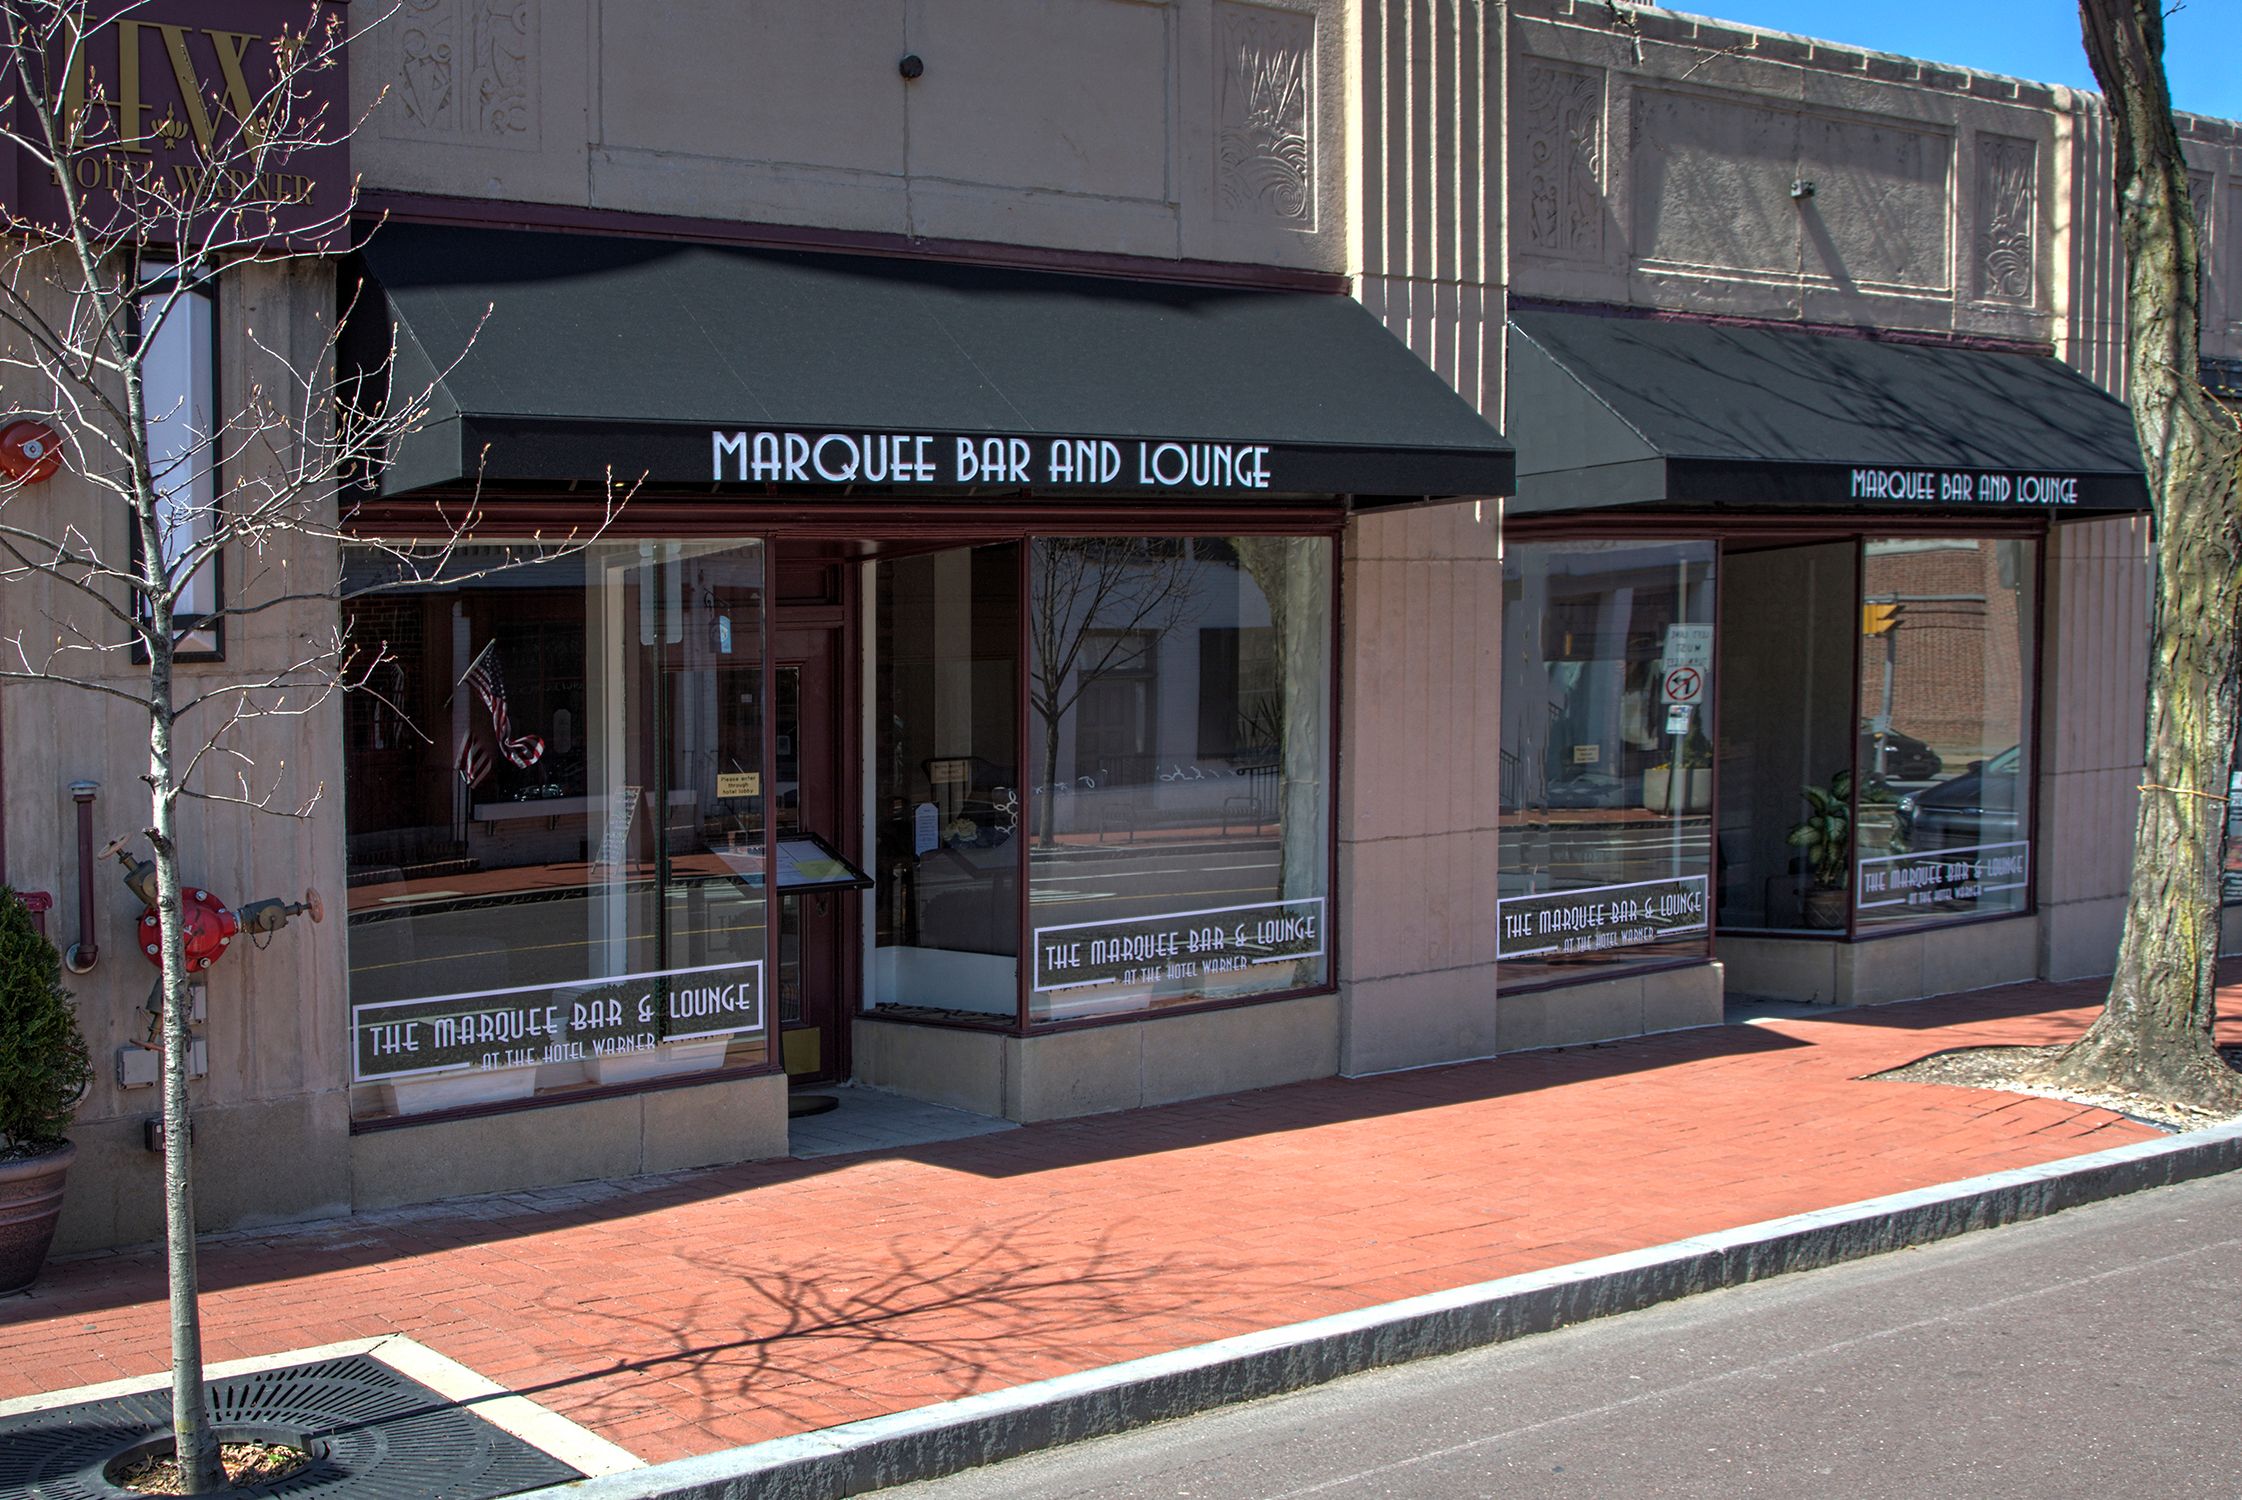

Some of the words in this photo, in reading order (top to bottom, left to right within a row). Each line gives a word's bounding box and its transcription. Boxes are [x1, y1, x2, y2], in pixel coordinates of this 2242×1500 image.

[172, 163, 315, 206] WARNER
[711, 430, 937, 483] MARQUEE
[956, 436, 1032, 484] BAR
[1048, 438, 1123, 485] AND
[1139, 441, 1272, 488] LOUNGE
[1850, 468, 1936, 500] MARQUEE
[1941, 472, 1974, 501] BAR
[1977, 474, 2011, 502] AND
[2015, 475, 2078, 504] LOUNGE
[1864, 872, 1886, 892] THE
[1890, 864, 1943, 889] MARQUEE
[1946, 861, 1969, 881] BAR
[1974, 860, 1982, 879] &
[1987, 855, 2023, 877] LOUNGE
[1505, 912, 1532, 938] THE
[1539, 903, 1605, 934] MARQUEE
[1609, 899, 1638, 924] BAR
[1644, 897, 1653, 919] &
[1660, 891, 1702, 917] LOUNGE
[1045, 943, 1081, 970] THE
[1091, 932, 1179, 965] MARQUEE
[1187, 926, 1225, 953] BAR
[1235, 923, 1247, 947] &
[1257, 916, 1316, 945] LOUNGE
[1562, 938, 1574, 953] AT
[1576, 935, 1591, 952] THE
[1595, 931, 1618, 950] HOTEL
[1620, 926, 1654, 944] WARNER
[1123, 970, 1138, 985] AT
[1140, 966, 1161, 983] THE
[1166, 961, 1198, 980] HOTEL
[1201, 956, 1248, 975] WARNER
[369, 1022, 419, 1056] THE
[434, 1005, 558, 1048] MARQUEE
[569, 998, 623, 1031] BAR
[637, 994, 655, 1023] &
[669, 983, 751, 1019] LOUNGE
[480, 1052, 502, 1071] AT
[505, 1047, 535, 1068] THE
[542, 1042, 587, 1063] HOTEL
[592, 1032, 656, 1057] WARNER
